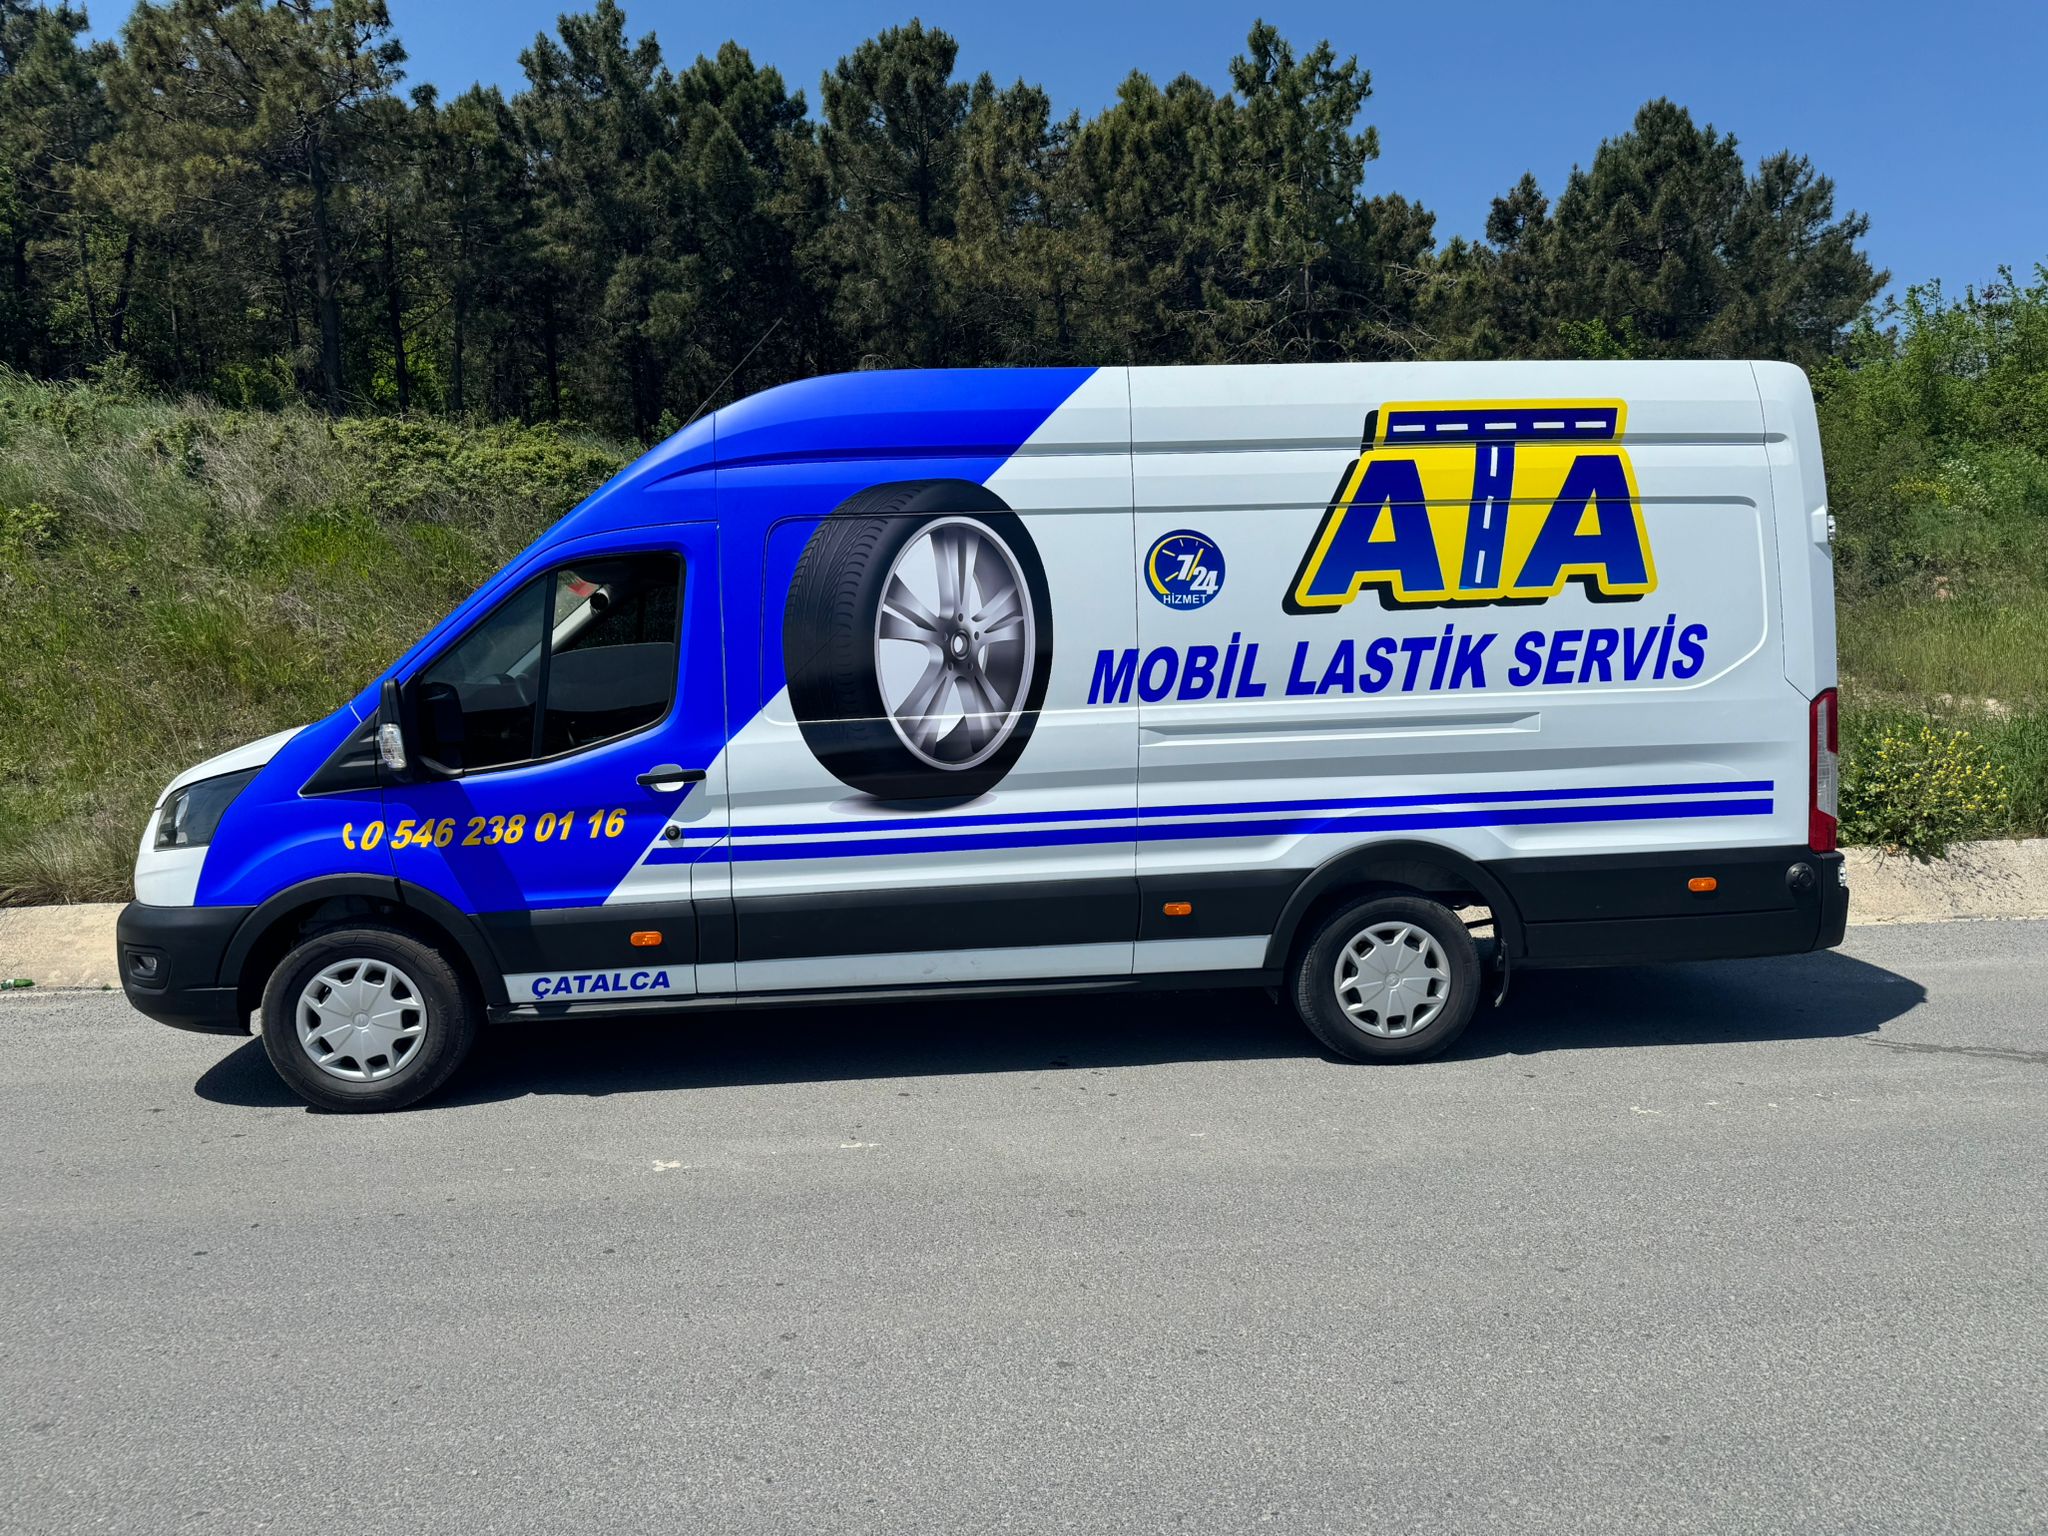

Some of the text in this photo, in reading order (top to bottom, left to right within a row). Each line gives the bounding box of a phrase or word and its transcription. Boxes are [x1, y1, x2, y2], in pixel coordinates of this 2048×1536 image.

[1302, 402, 1653, 601] ATA
[1163, 592, 1208, 605] HİZMET
[1086, 613, 1709, 705] MOBİL LASTİK SERVİS
[360, 808, 628, 851] 0 546 238 01 16
[531, 970, 671, 1001] ÇATALCA
